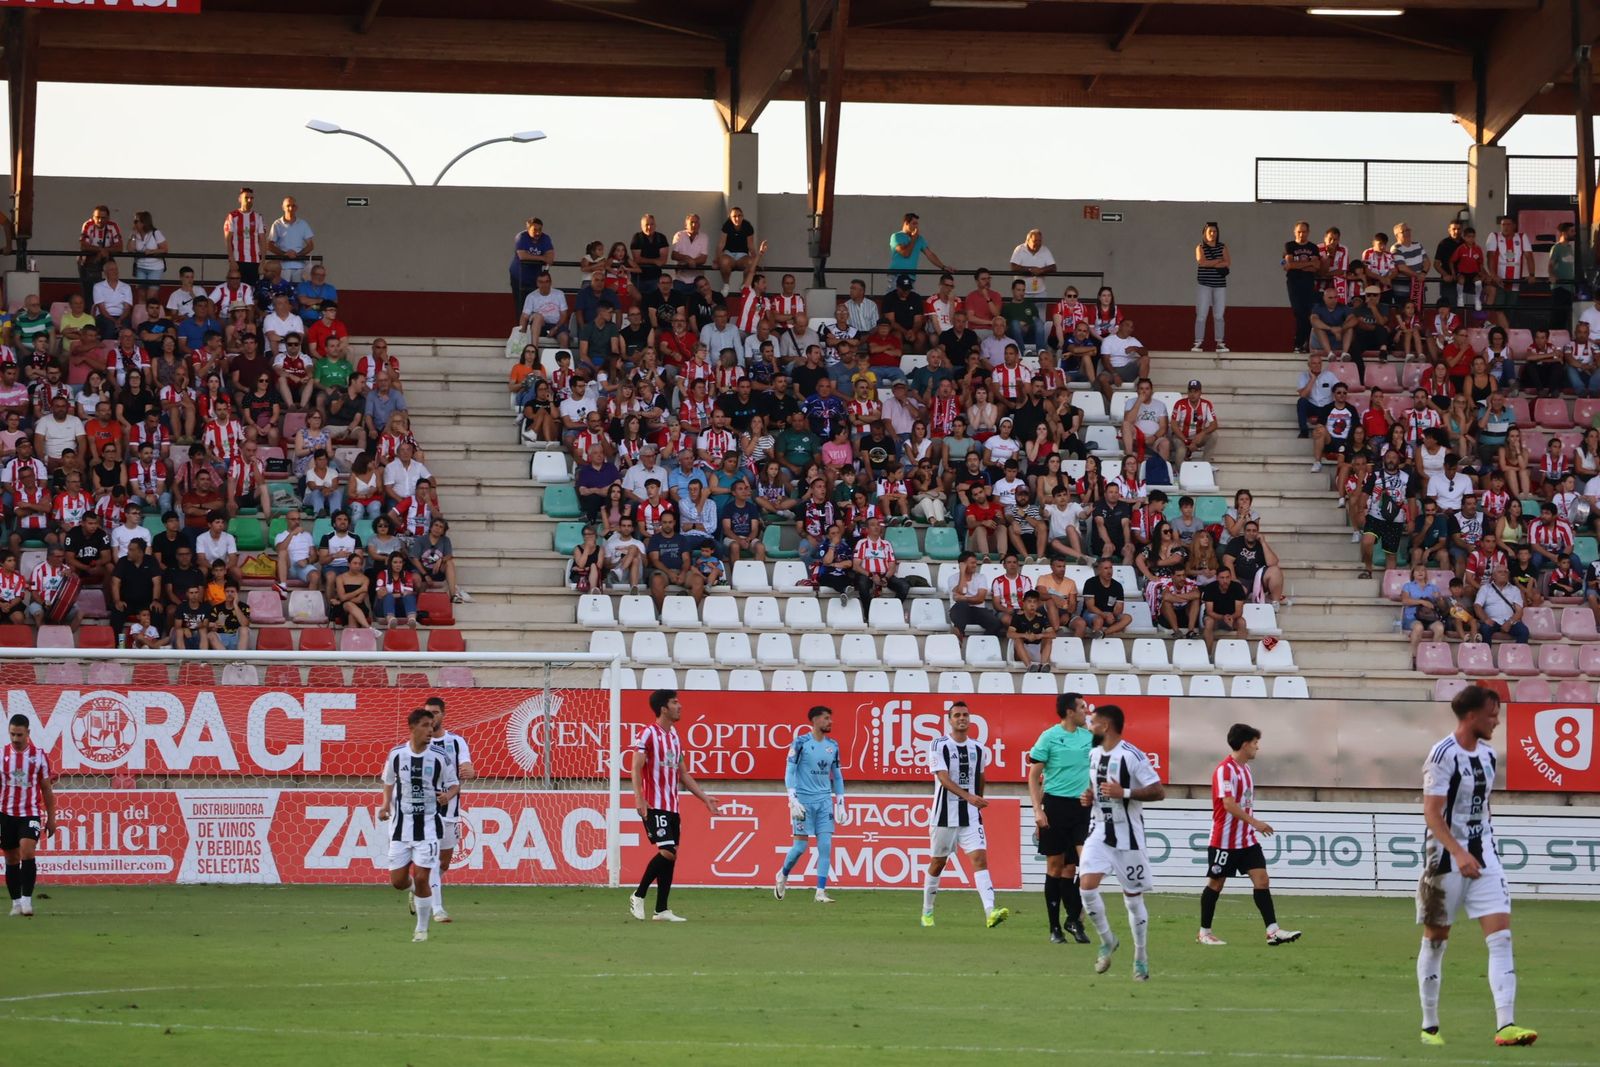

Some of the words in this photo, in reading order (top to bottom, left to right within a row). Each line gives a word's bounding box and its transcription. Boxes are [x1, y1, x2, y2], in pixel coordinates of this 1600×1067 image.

[0, 689, 240, 770] MORA
[247, 691, 357, 772] CF
[531, 721, 647, 748] CENTR
[1554, 716, 1580, 758] 8
[596, 749, 754, 775] RORTO
[1520, 735, 1563, 786] ZAMORA
[123, 805, 149, 820] del
[193, 803, 264, 816] DISTRIBUIDORA
[655, 815, 668, 828] 16
[36, 812, 168, 851] miller
[198, 822, 214, 838] DE
[218, 822, 255, 838] VINOS
[304, 806, 557, 870] ZARA
[195, 841, 204, 856] Y
[207, 840, 262, 856] BEBIDAS
[429, 842, 437, 856] 11
[1214, 849, 1228, 866] 18
[197, 859, 260, 874] SELECTAS
[1126, 865, 1144, 881] 22
